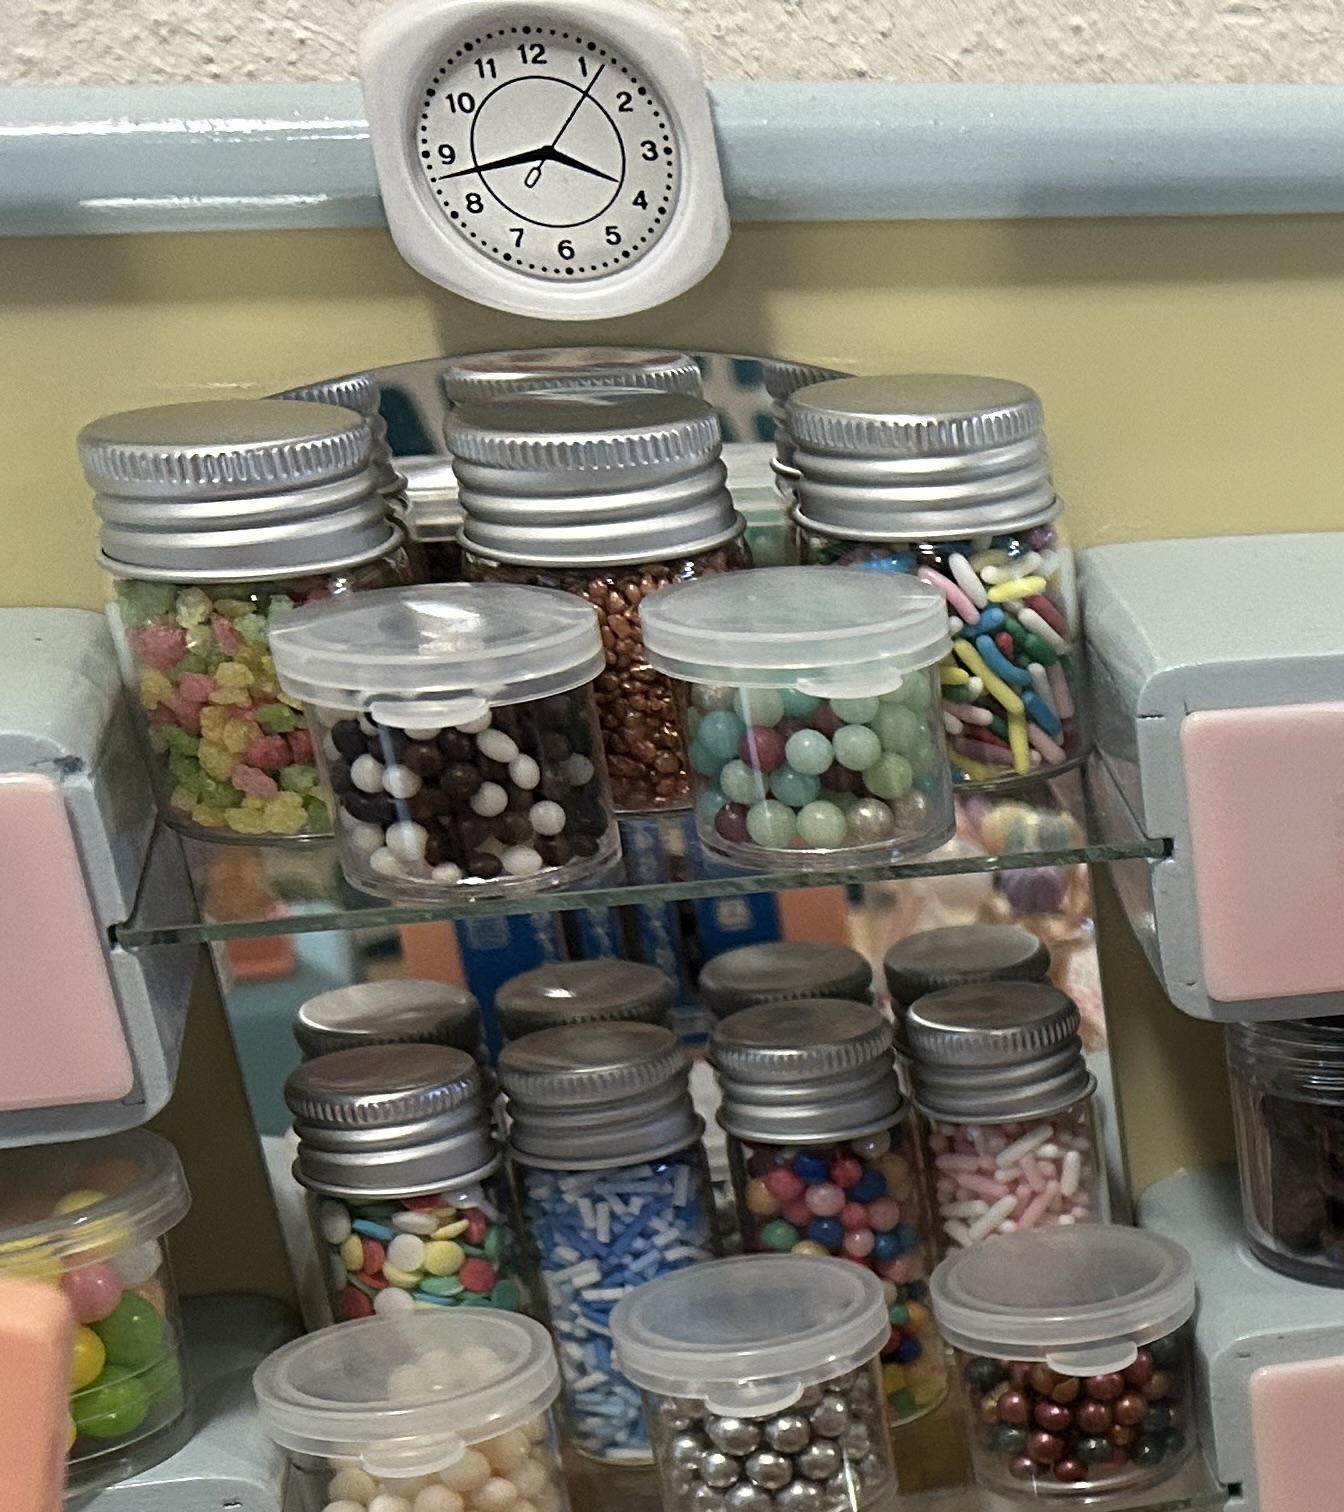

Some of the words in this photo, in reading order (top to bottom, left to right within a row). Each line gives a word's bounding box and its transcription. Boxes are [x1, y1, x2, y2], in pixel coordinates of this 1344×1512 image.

[517, 43, 547, 64] 12
[474, 58, 497, 79] 11
[578, 56, 588, 77] 1
[445, 92, 475, 114] 10
[616, 91, 634, 112] 2
[437, 143, 456, 165] 9
[640, 140, 659, 161] 3
[465, 192, 484, 214] 8
[632, 190, 648, 210] 4
[509, 228, 524, 248] 7
[605, 225, 622, 246] 5
[557, 239, 576, 261] 6
